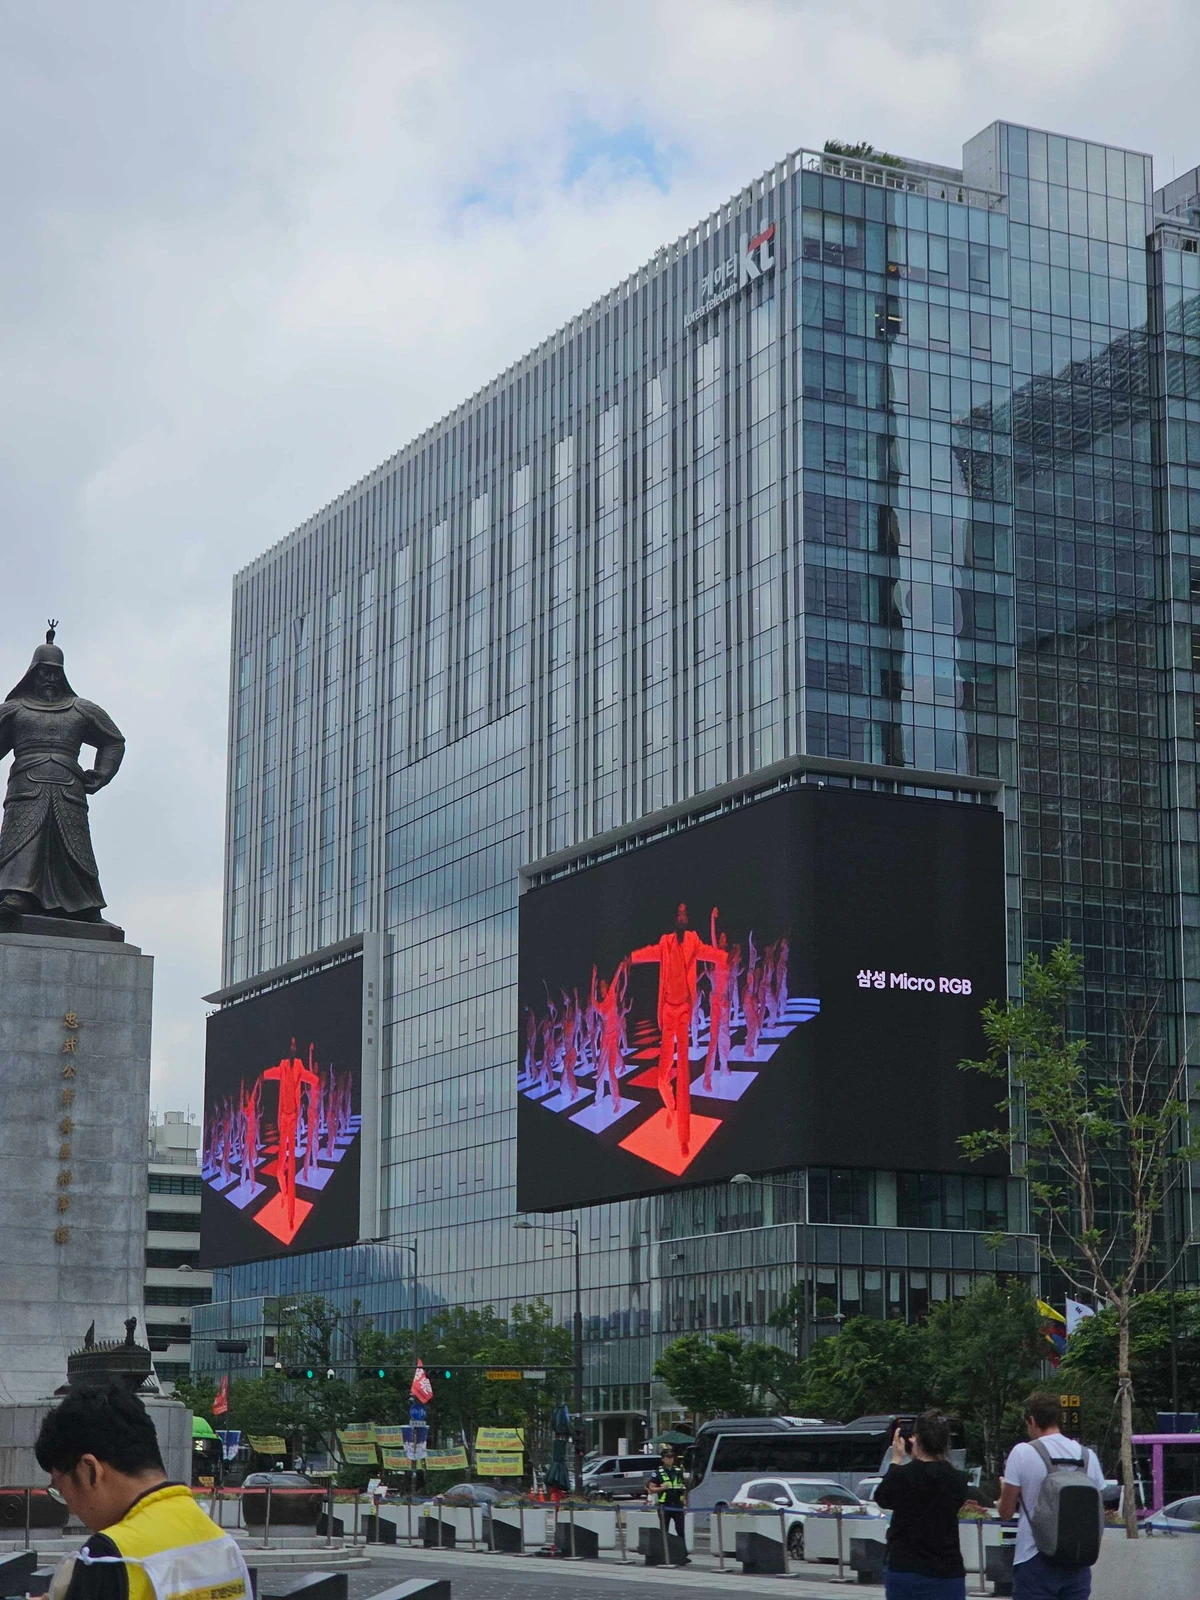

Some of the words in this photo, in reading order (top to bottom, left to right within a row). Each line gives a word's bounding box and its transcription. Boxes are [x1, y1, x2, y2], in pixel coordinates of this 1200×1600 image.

[856, 969, 886, 989] 삼성
[890, 972, 936, 992] Micro
[939, 977, 972, 995] RGB
